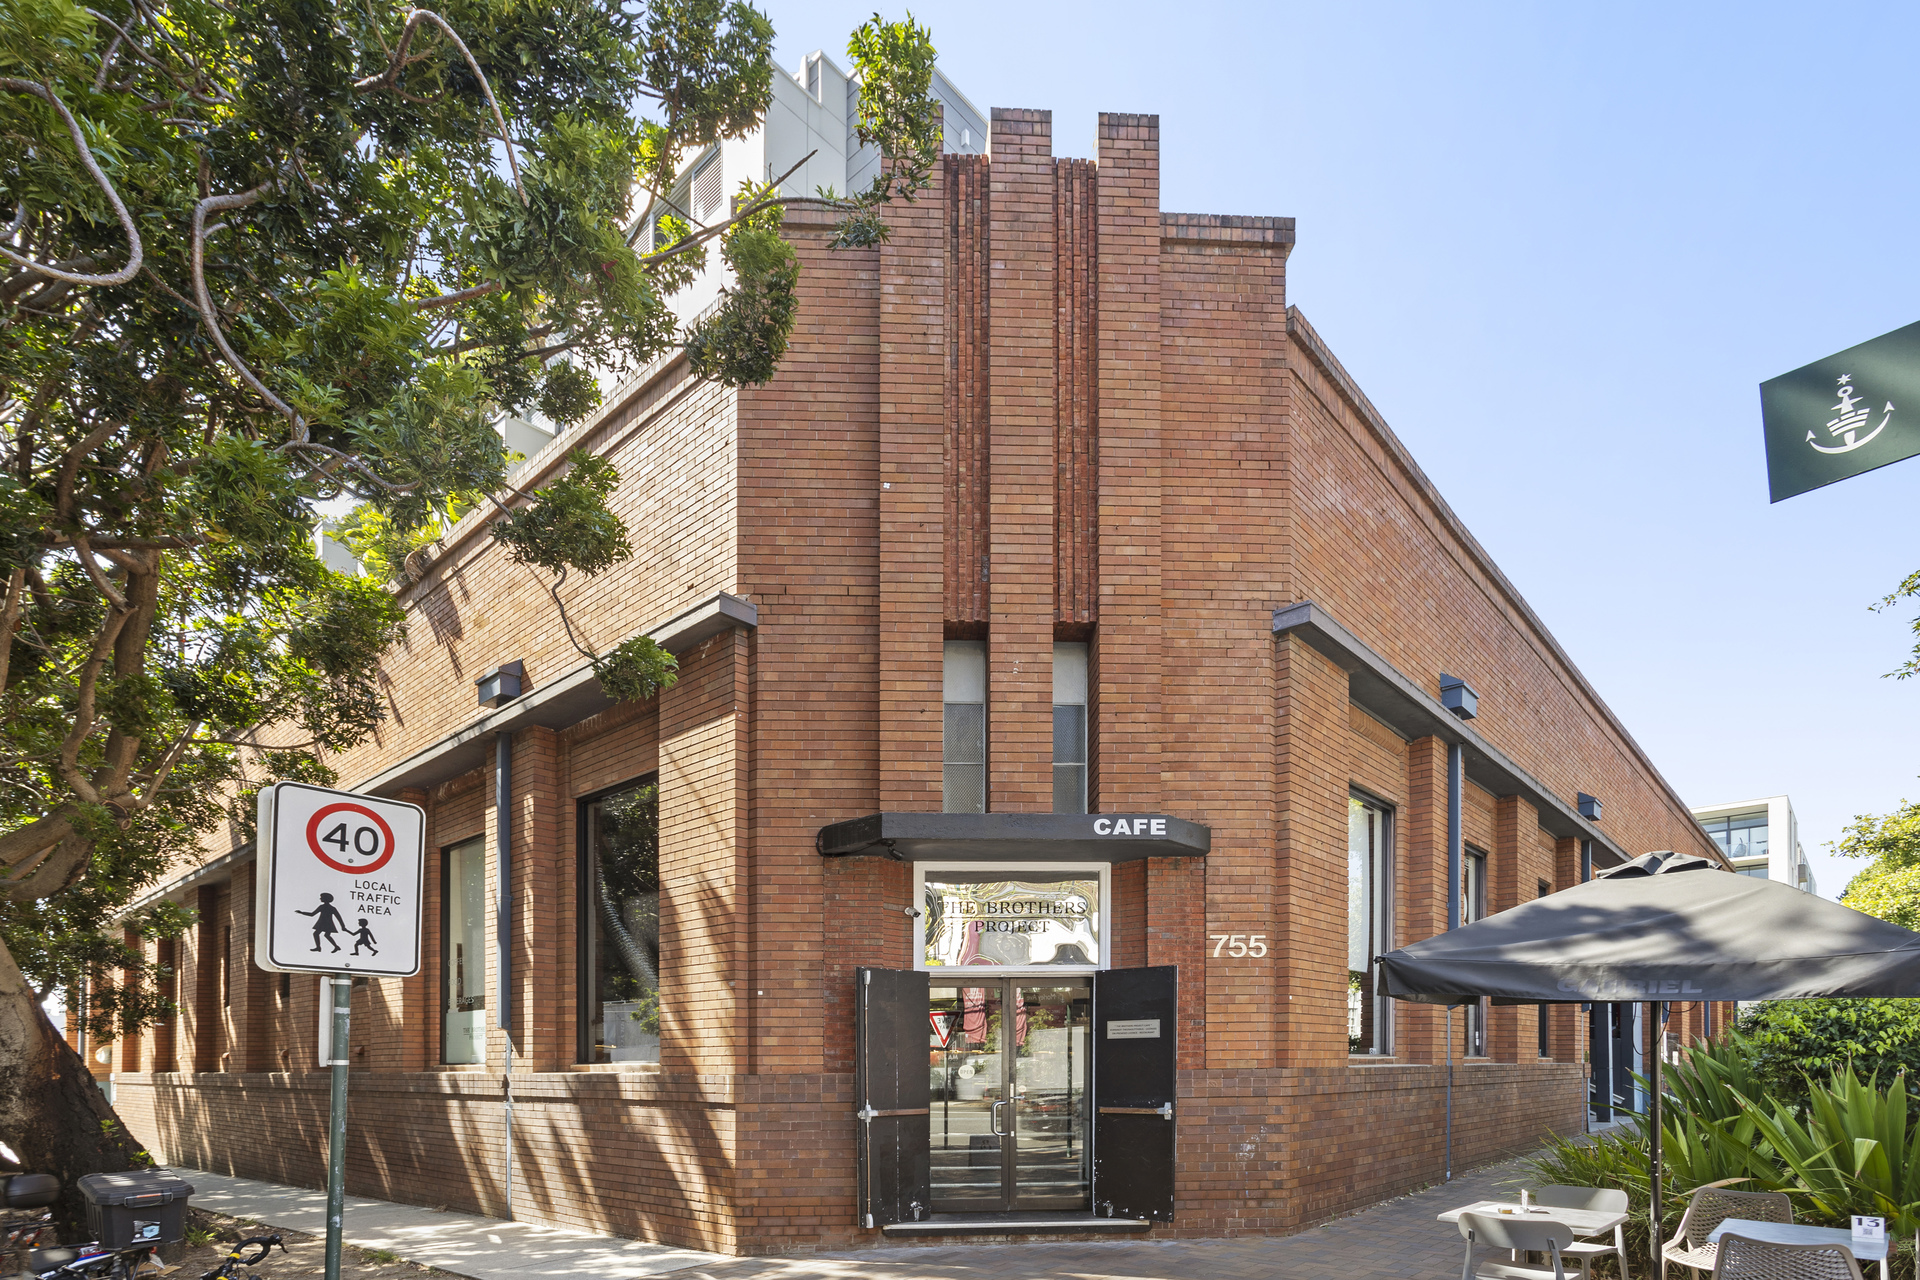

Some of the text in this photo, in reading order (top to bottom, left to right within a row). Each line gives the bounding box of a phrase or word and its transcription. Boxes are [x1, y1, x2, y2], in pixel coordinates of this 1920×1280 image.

[1093, 818, 1167, 836] CAFE
[322, 822, 379, 856] 40
[354, 879, 395, 893] LOCAL
[350, 890, 401, 905] TRAFFIC
[357, 903, 392, 916] AREA
[938, 901, 1086, 914] THE BROTHERS
[974, 920, 1051, 934] PROJECT
[1209, 934, 1268, 958] 755
[1557, 978, 1703, 994] GABRIEL
[1855, 1217, 1880, 1228] 13
